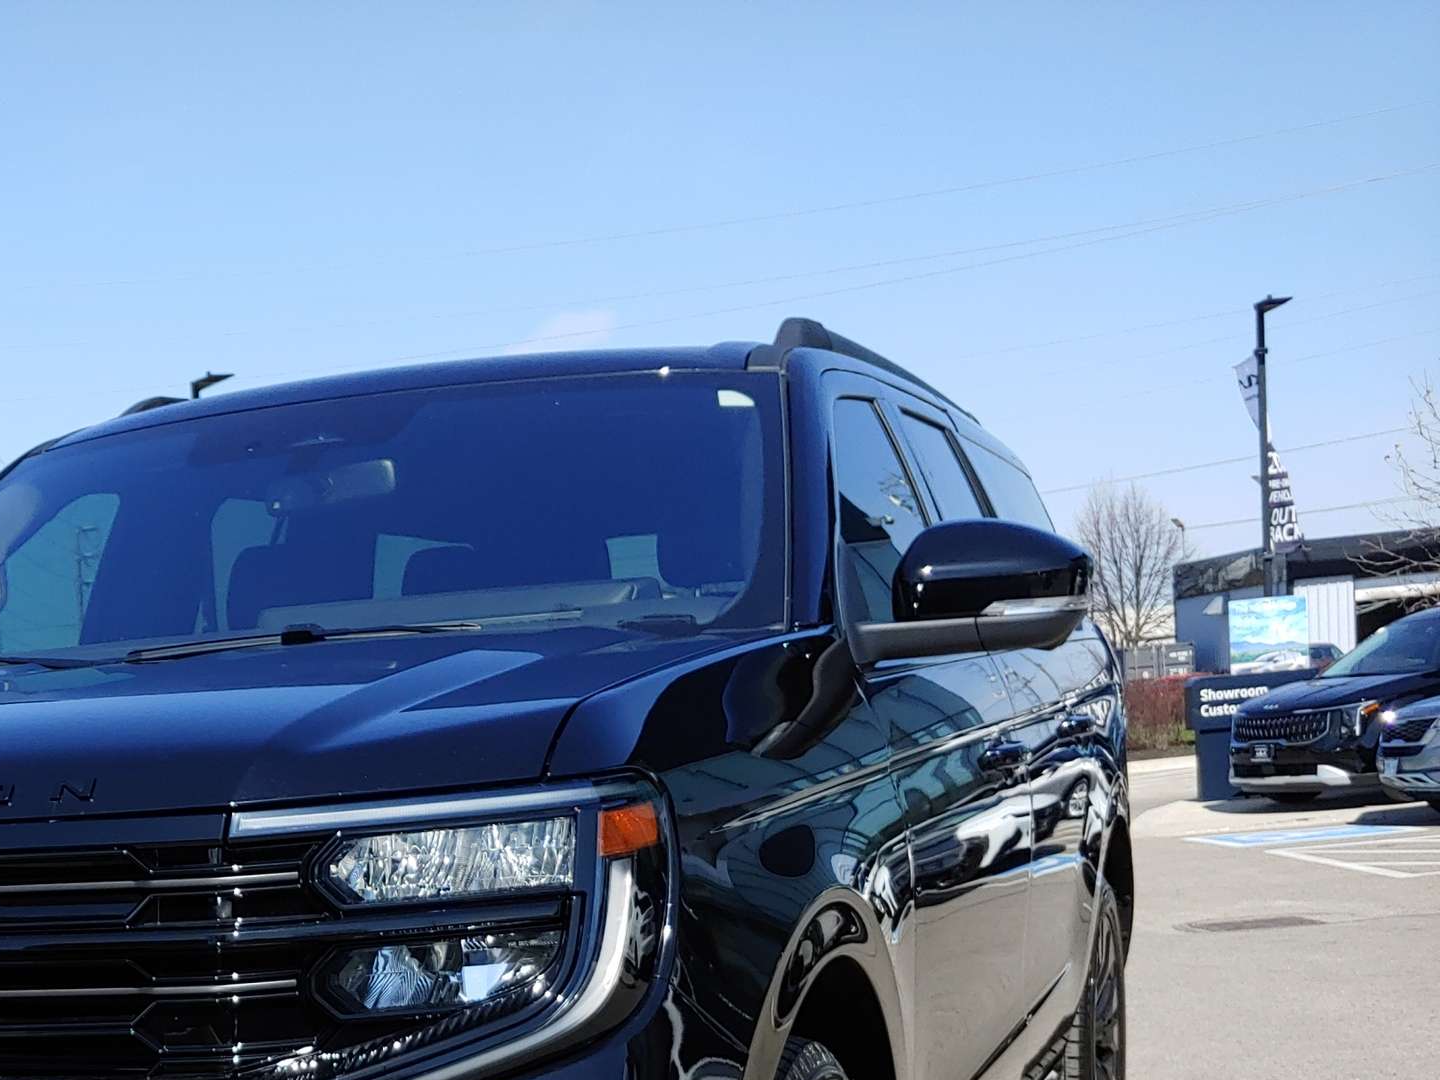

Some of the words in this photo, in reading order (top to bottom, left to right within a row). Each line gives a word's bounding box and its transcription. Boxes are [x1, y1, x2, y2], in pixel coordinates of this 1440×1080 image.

[1271, 505, 1297, 525] OUT
[1199, 685, 1268, 702] Showroom
[1200, 703, 1240, 717] Custo
